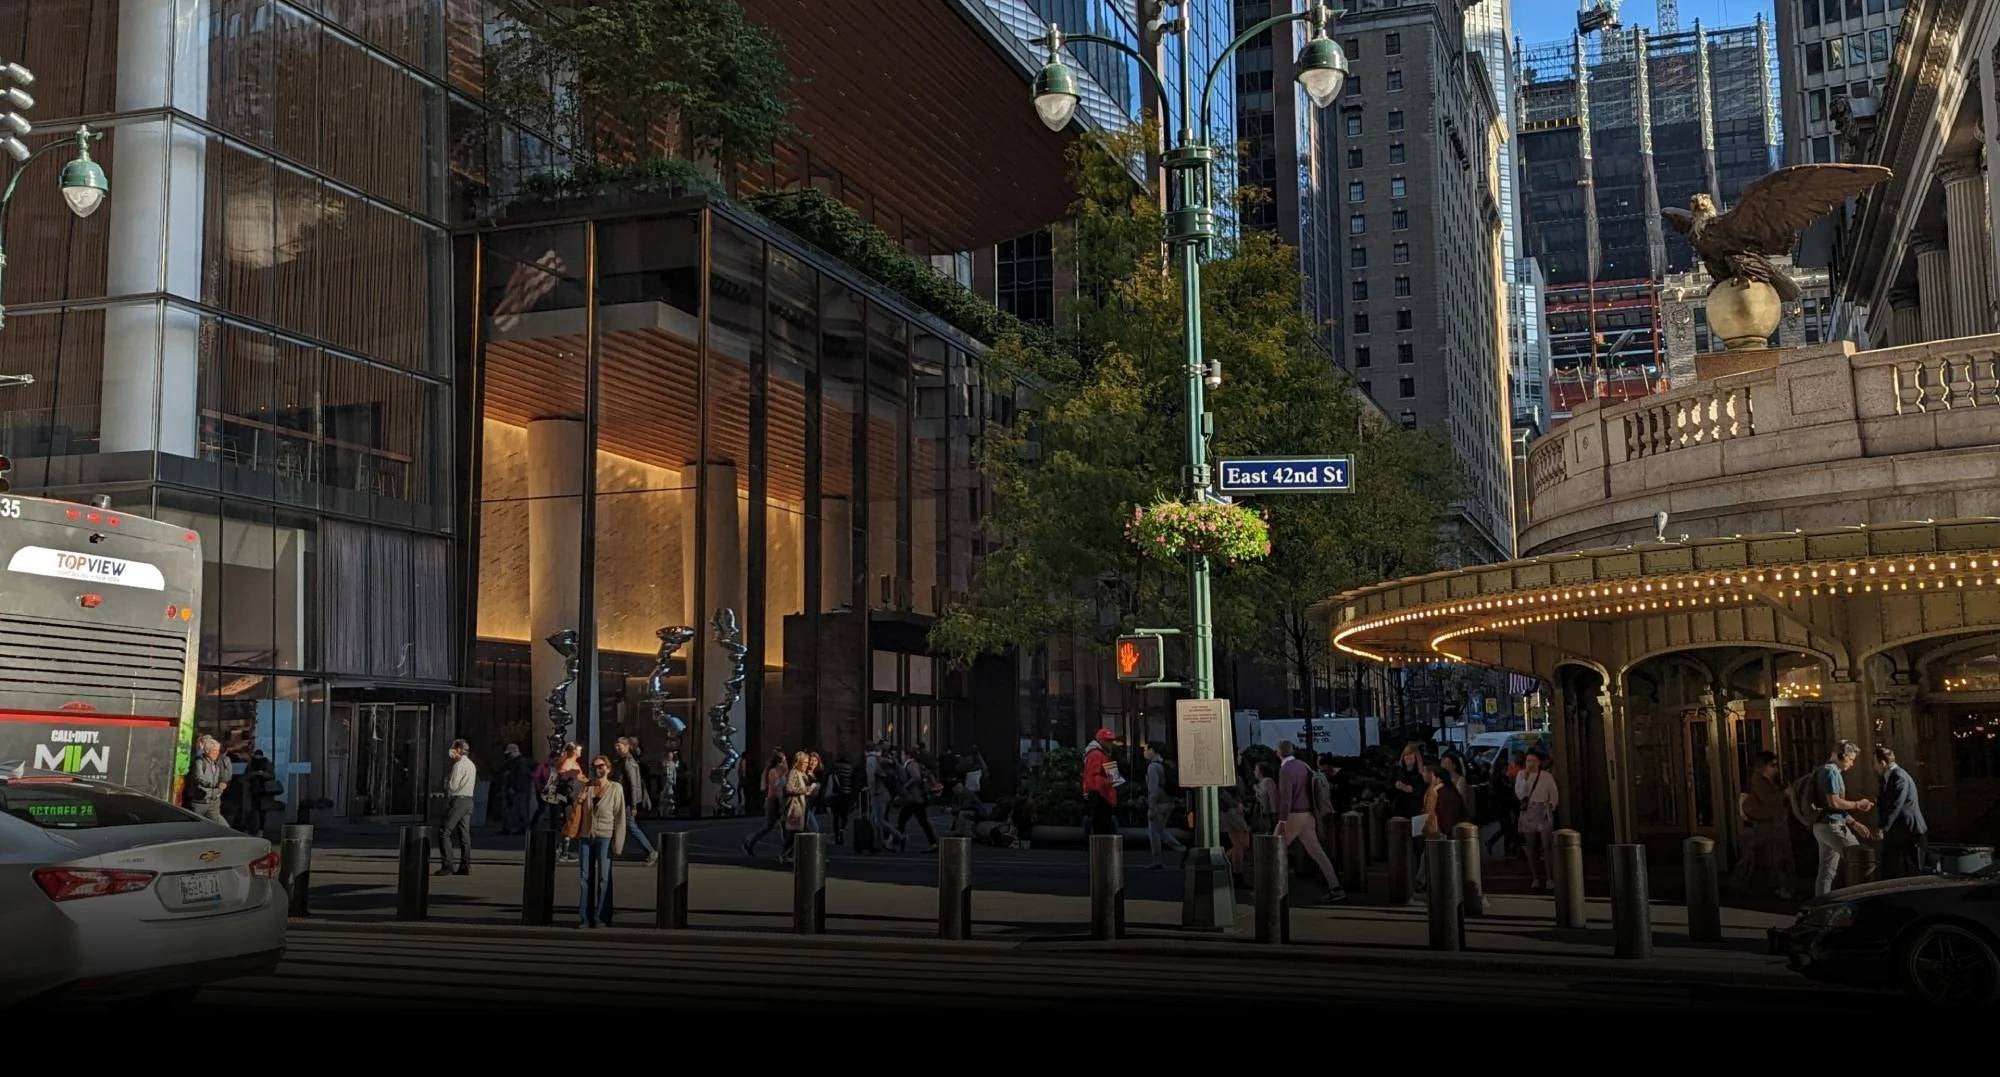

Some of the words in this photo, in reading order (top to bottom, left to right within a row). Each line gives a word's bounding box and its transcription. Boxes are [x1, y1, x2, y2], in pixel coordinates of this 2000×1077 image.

[1226, 467, 1268, 484] East
[1272, 466, 1318, 483] 42nd
[1323, 466, 1344, 483] St
[57, 552, 126, 576] TOPVIEW
